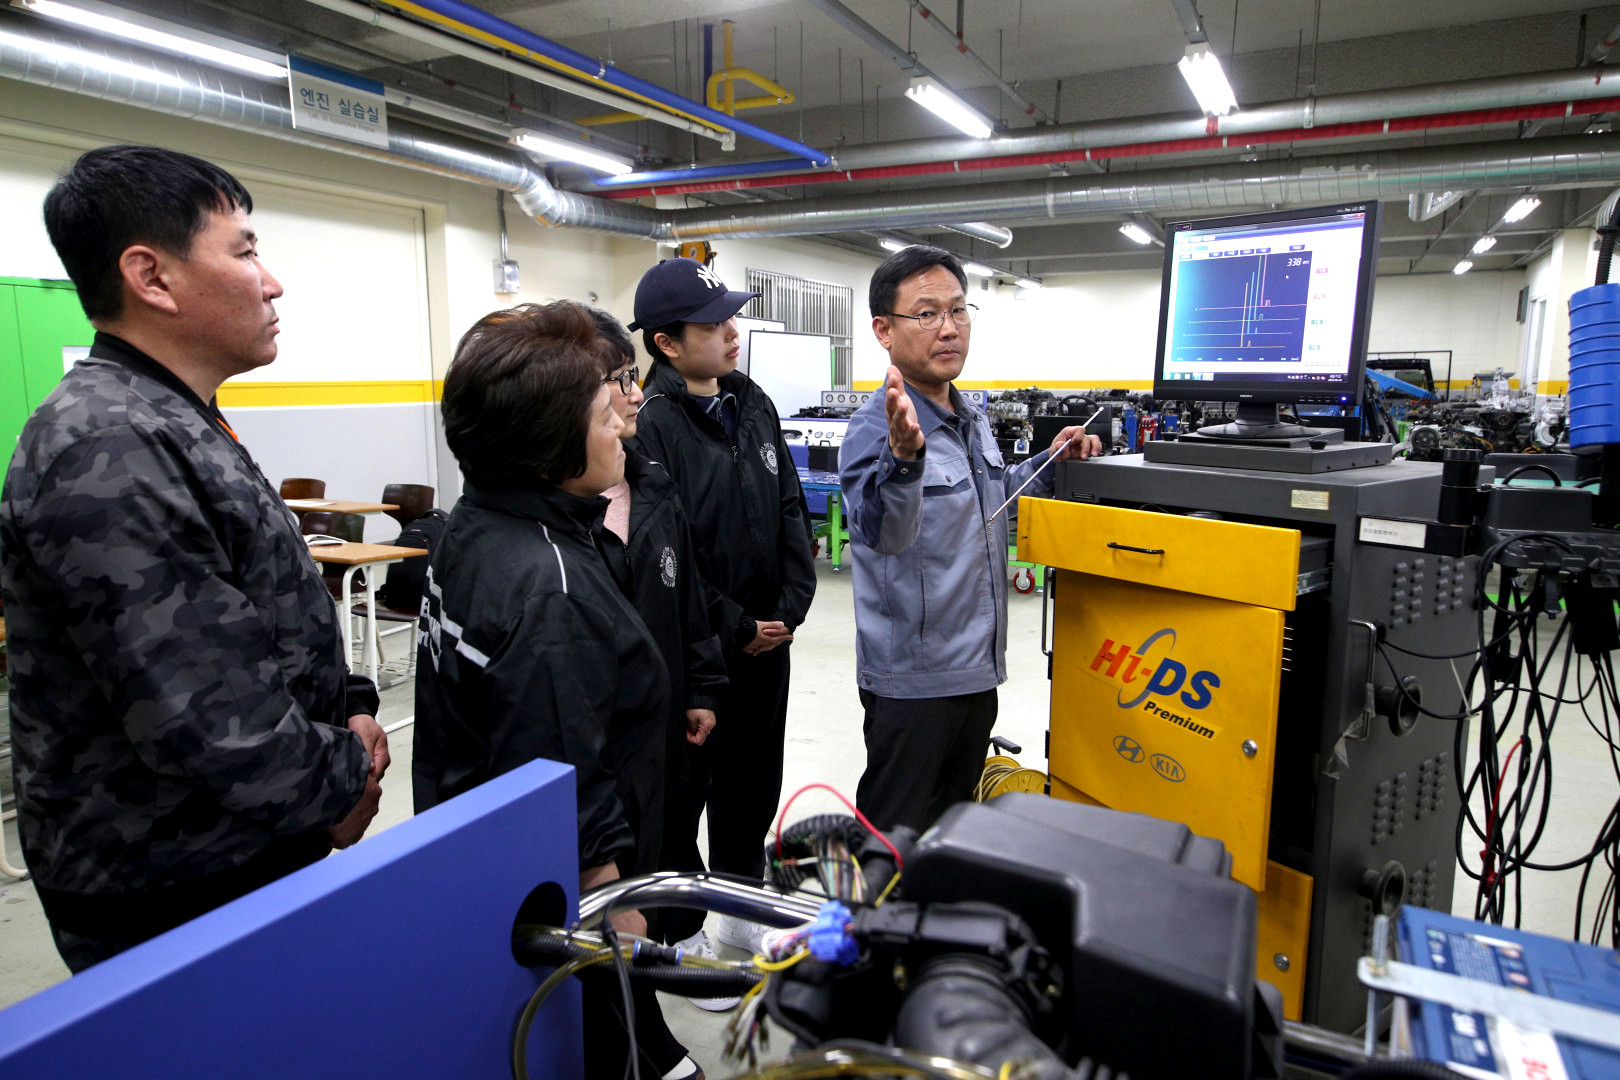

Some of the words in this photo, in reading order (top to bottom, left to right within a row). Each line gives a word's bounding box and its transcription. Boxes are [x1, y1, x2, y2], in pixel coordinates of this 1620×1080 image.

[300, 87, 330, 111] 엔진
[338, 98, 379, 123] 실습실
[1287, 257, 1302, 267] 338
[1089, 638, 1221, 710] Hi-DS
[1143, 701, 1215, 739] Premium
[1155, 757, 1181, 780] KIA
